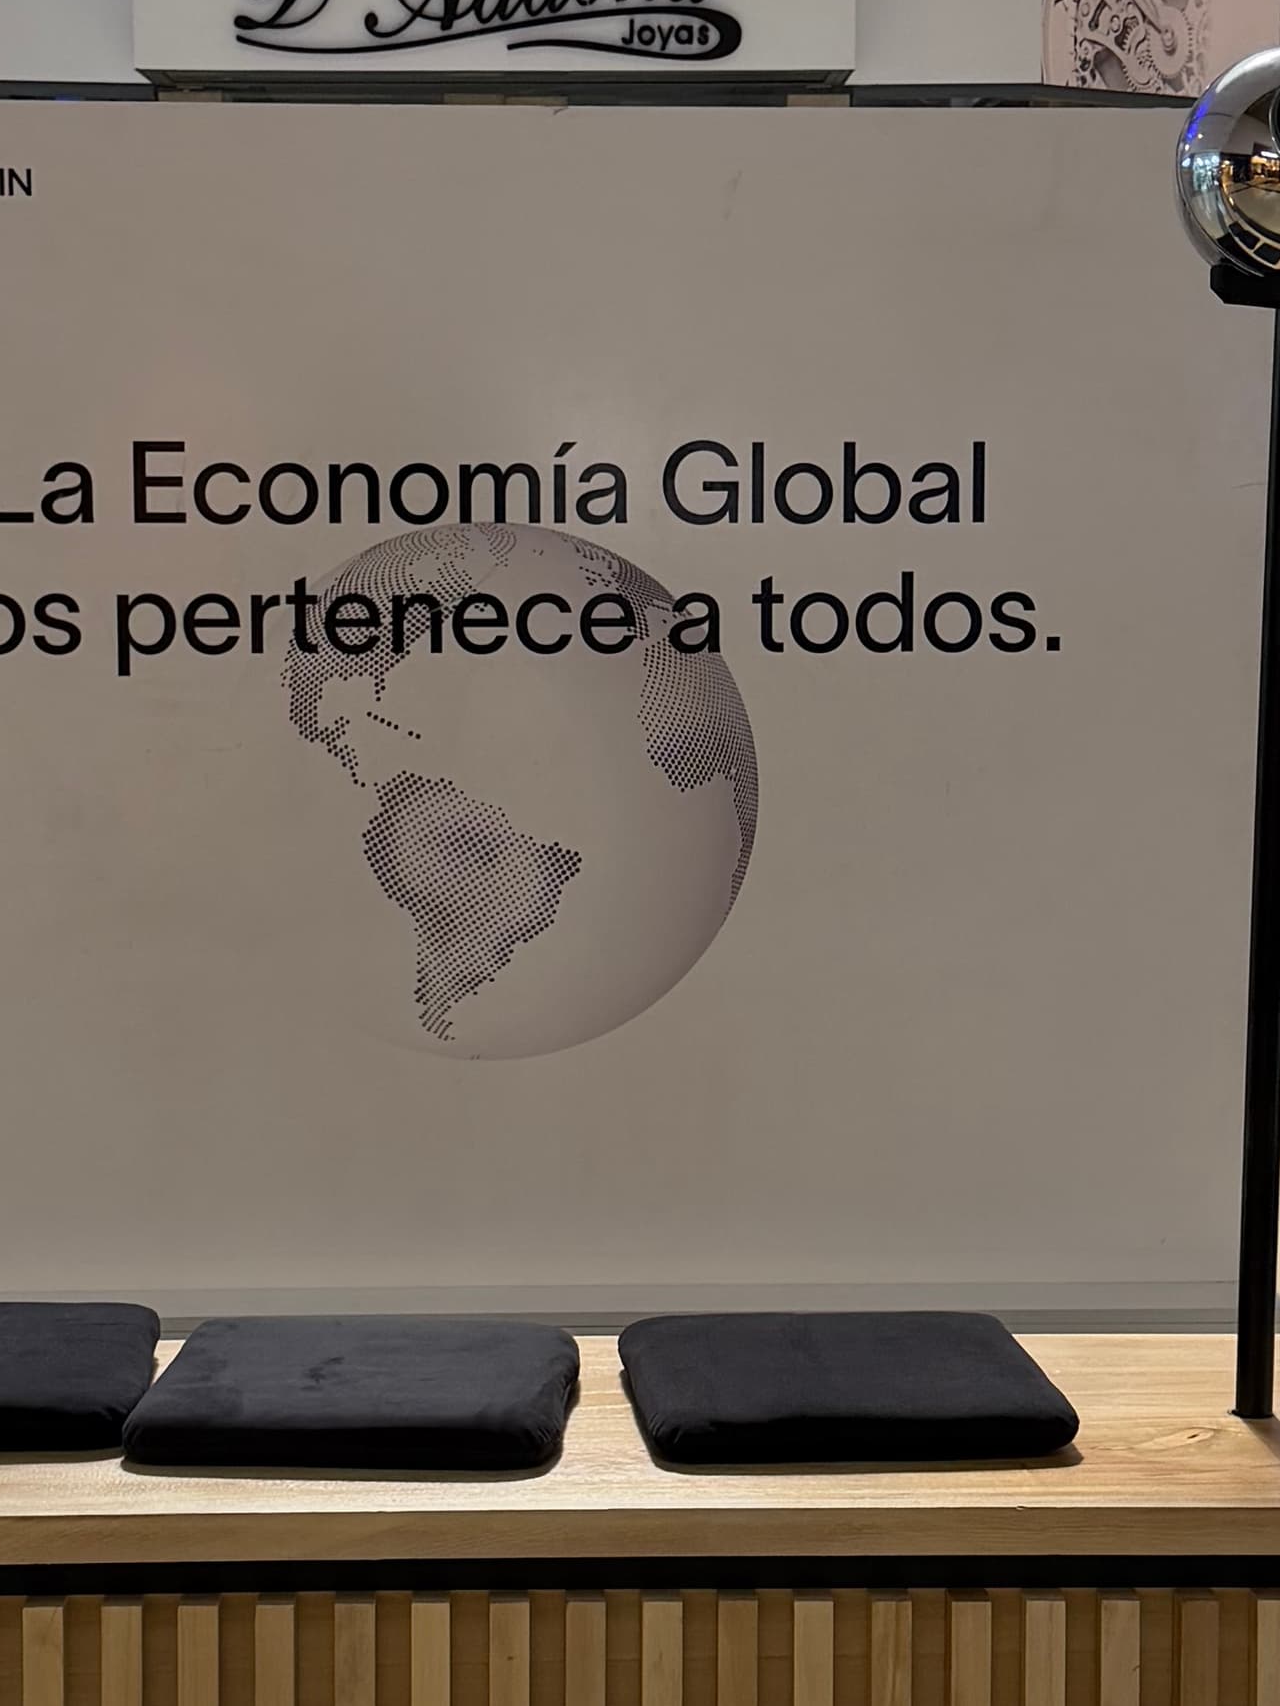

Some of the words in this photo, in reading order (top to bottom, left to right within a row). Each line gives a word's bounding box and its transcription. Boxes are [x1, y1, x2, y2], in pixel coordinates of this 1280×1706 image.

[621, 18, 710, 51] Joyas
[132, 440, 628, 526] Economía
[662, 440, 986, 526] Global
[116, 577, 638, 677] pertenece
[667, 592, 721, 656] a
[751, 571, 1061, 654] todos.
